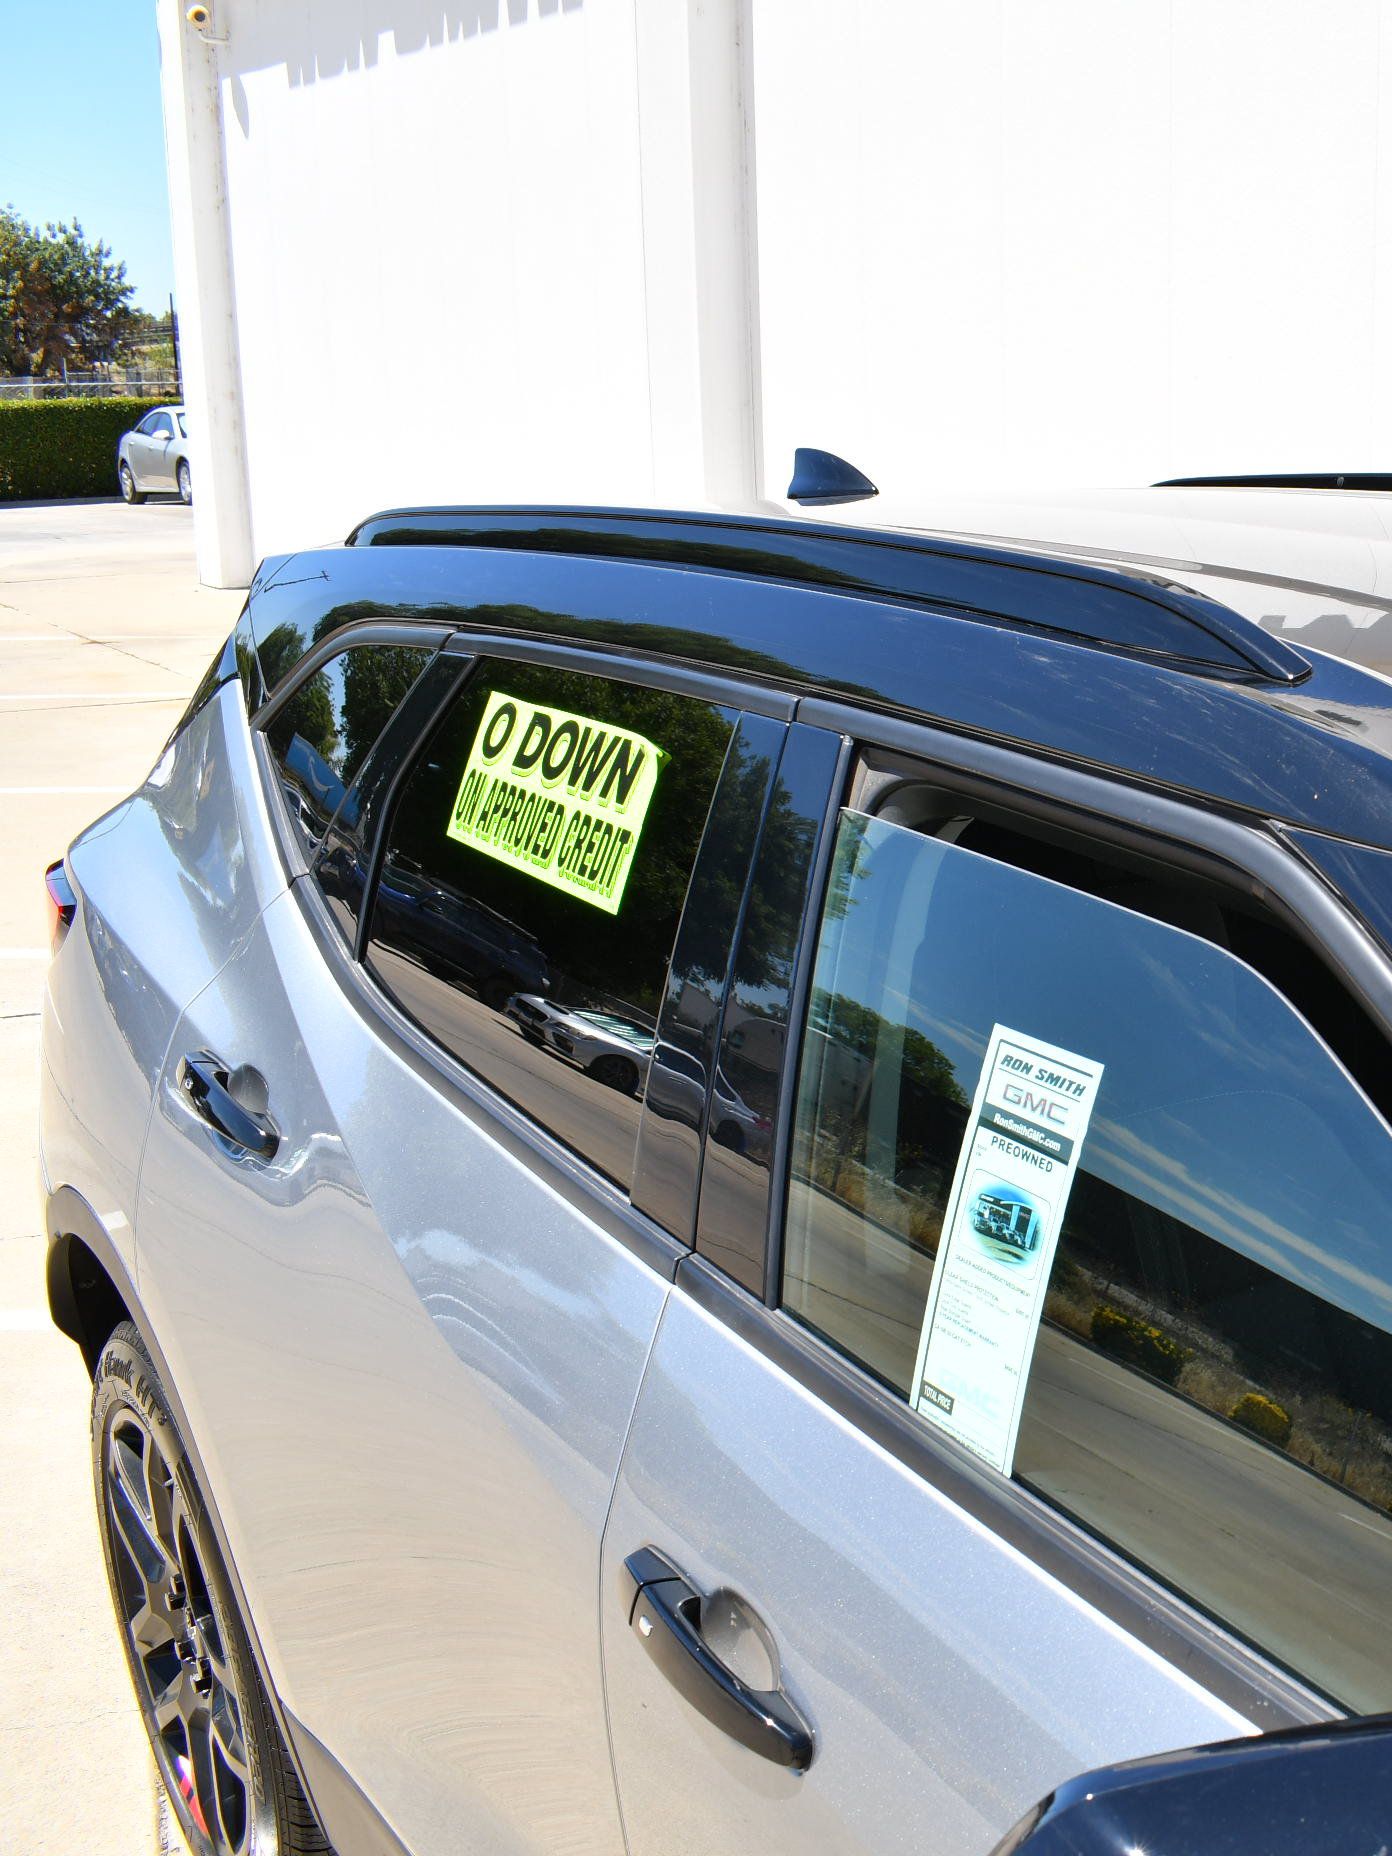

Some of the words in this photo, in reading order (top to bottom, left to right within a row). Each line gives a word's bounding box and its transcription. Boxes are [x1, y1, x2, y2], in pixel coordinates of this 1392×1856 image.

[511, 711, 646, 806] DOWN
[455, 769, 488, 826] ON
[476, 778, 566, 860] APPROVED
[557, 809, 633, 889] CREDIT
[1000, 1054, 1033, 1075] RON
[1035, 1068, 1087, 1097] SMITH
[1002, 1083, 1069, 1125] GMC
[993, 1113, 1061, 1152] RonSmithGMC.com
[990, 1136, 1053, 1173] PREOWNED
[924, 1384, 938, 1402] TOTAL
[937, 1393, 952, 1410] PRICE
